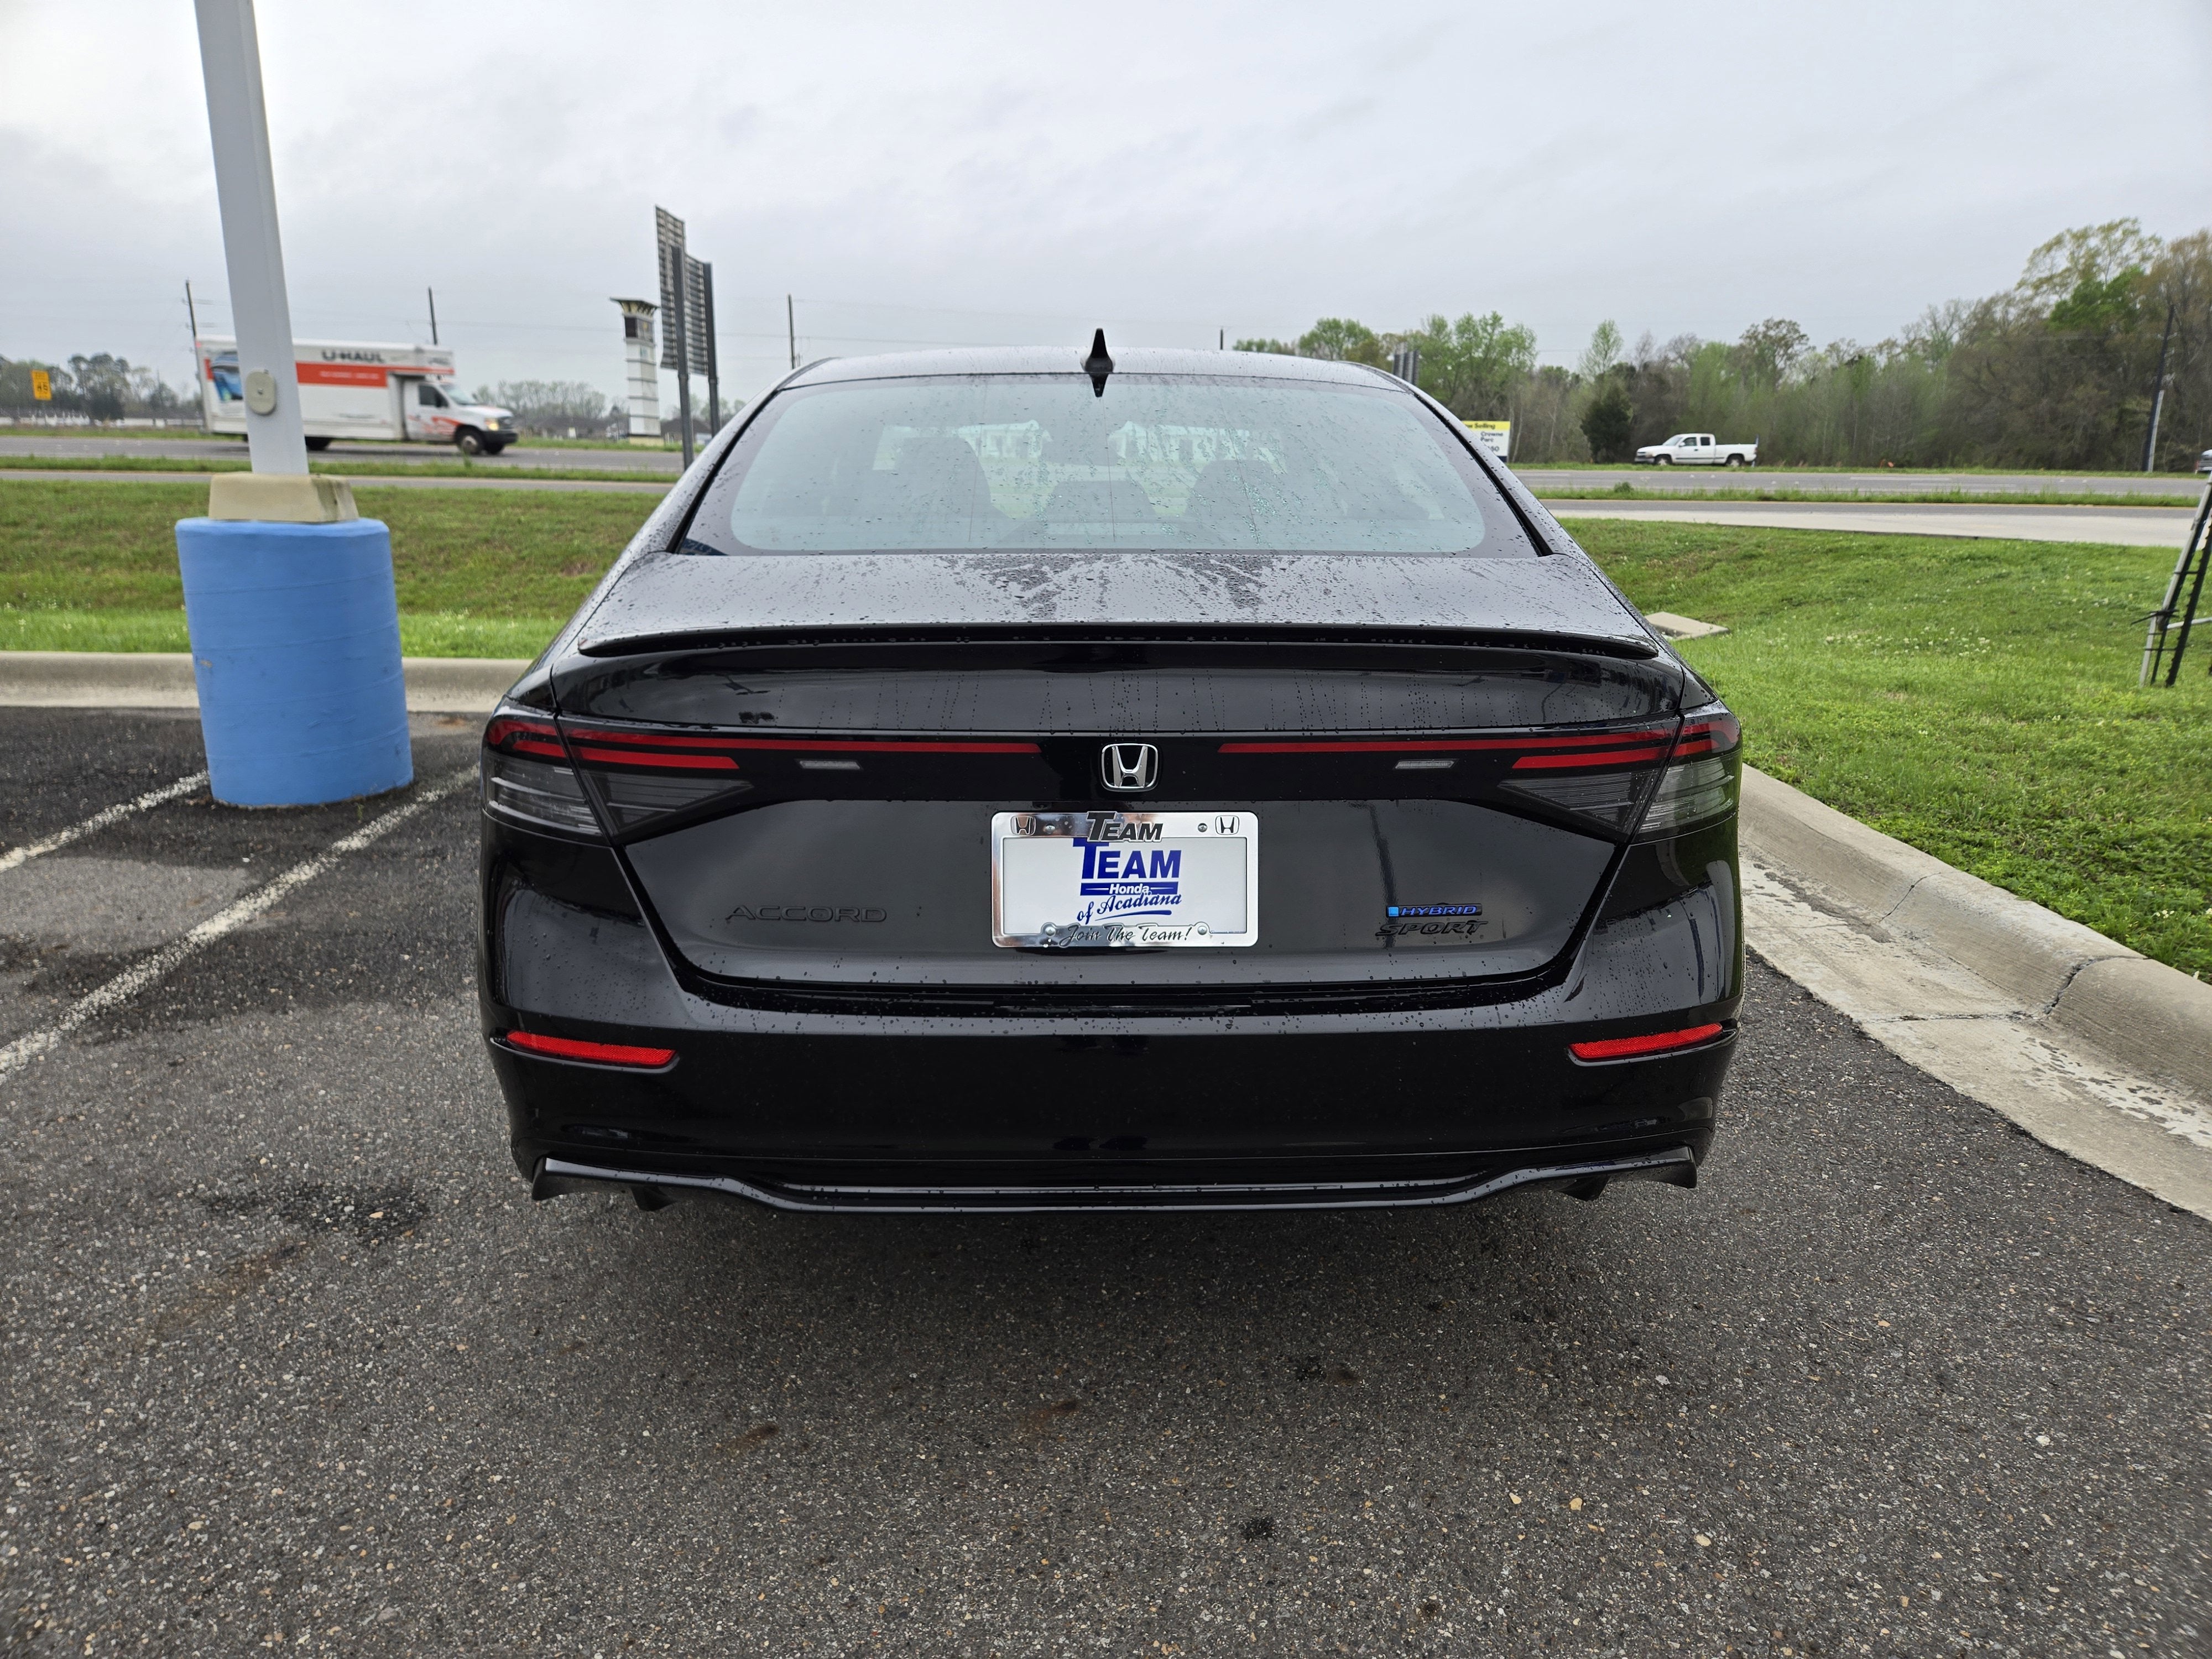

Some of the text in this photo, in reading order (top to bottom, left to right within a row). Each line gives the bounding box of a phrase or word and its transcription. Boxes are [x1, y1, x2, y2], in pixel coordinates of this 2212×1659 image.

[1087, 811, 1164, 841] TEAM
[1073, 837, 1181, 879] TEAM
[1109, 884, 1150, 895] Honda
[725, 905, 887, 922] ACCORD
[1077, 891, 1182, 925] of Acadiana
[1401, 905, 1478, 916] HYBRID
[1058, 924, 1192, 947] Join The Team!
[1375, 920, 1488, 936] SPORT
